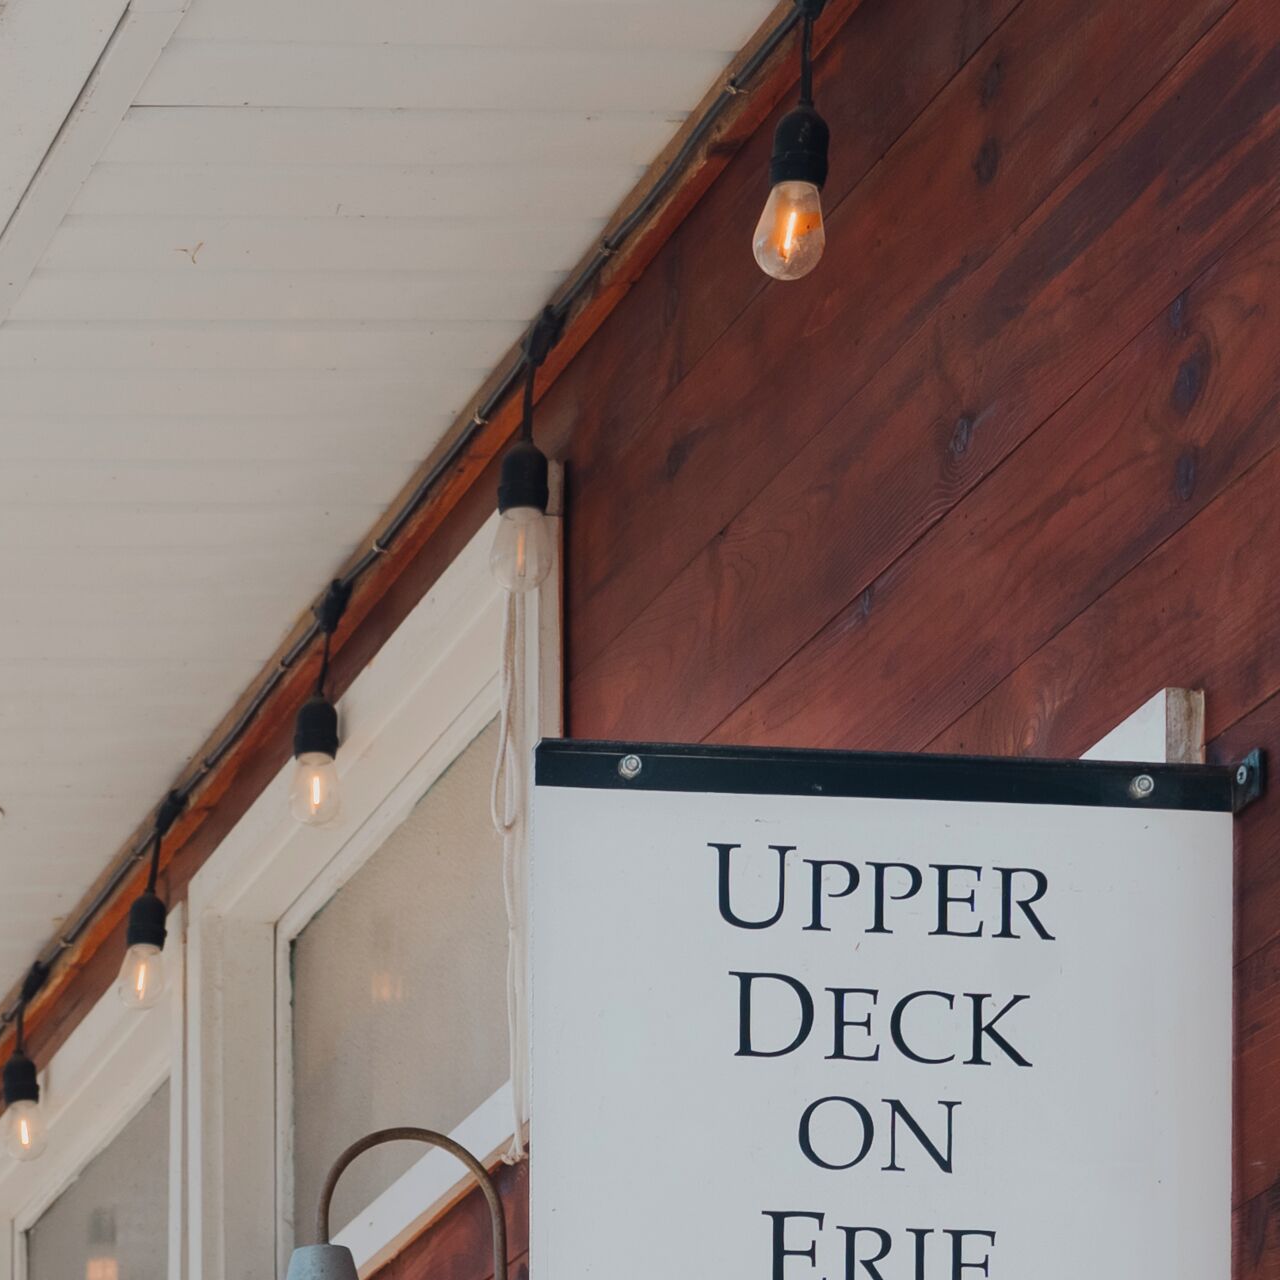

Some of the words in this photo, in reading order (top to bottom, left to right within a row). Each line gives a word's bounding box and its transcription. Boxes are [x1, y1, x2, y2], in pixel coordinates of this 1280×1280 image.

[707, 842, 1056, 941] UPPER
[728, 971, 1033, 1067] DECK
[798, 1096, 962, 1174] ON
